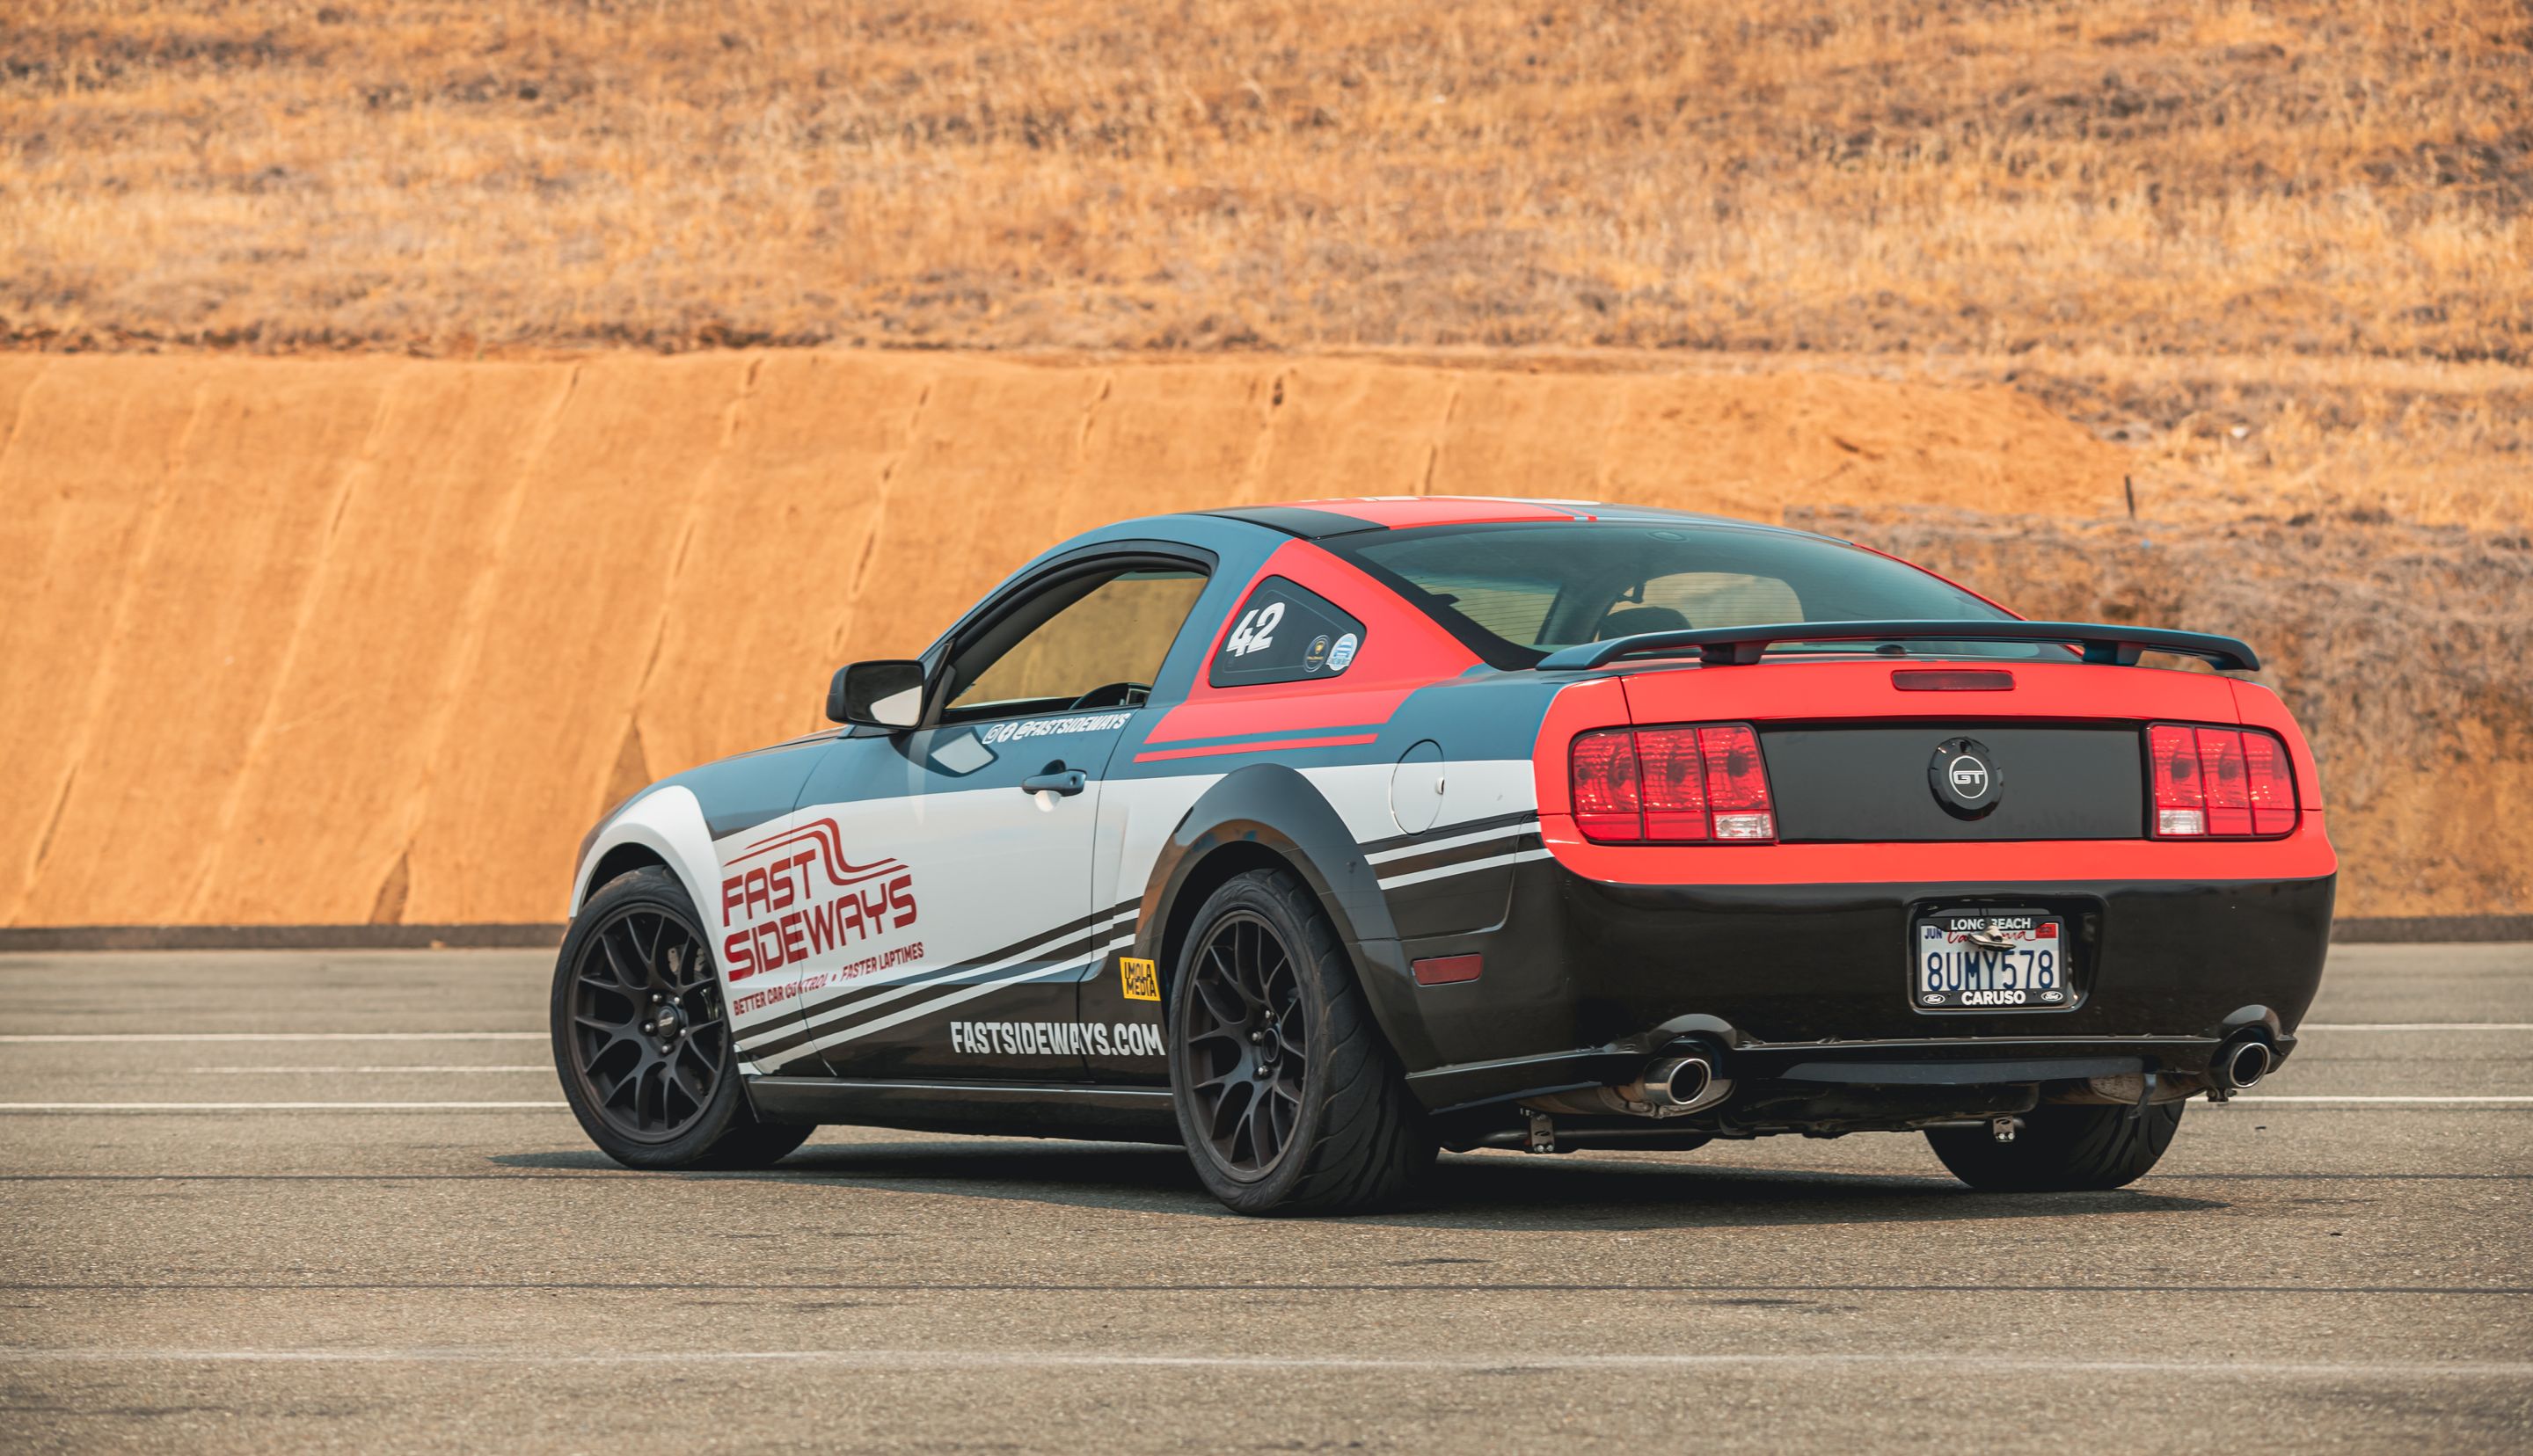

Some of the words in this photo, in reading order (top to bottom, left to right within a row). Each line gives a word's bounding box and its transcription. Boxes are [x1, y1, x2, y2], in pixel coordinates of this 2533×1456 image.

[1226, 601, 1285, 657] 42
[1012, 712, 1131, 740] @FASTSIDEWAYS
[1953, 770, 1983, 783] GT
[722, 848, 816, 927] FAST
[724, 874, 917, 982] SIDEWAYS
[1924, 928, 1943, 939] JUN
[1951, 919, 1985, 930] LONG
[734, 992, 766, 1016] BETTER
[767, 986, 785, 1005] CAR
[785, 973, 828, 998] CONTROL
[841, 957, 877, 981] FASTER
[880, 942, 923, 970] LAPTIMES
[1928, 950, 2053, 991] 8UMY578
[1961, 991, 2026, 1004] CARUSO
[950, 1021, 1166, 1056] FASTSIDEWAYS.COM
